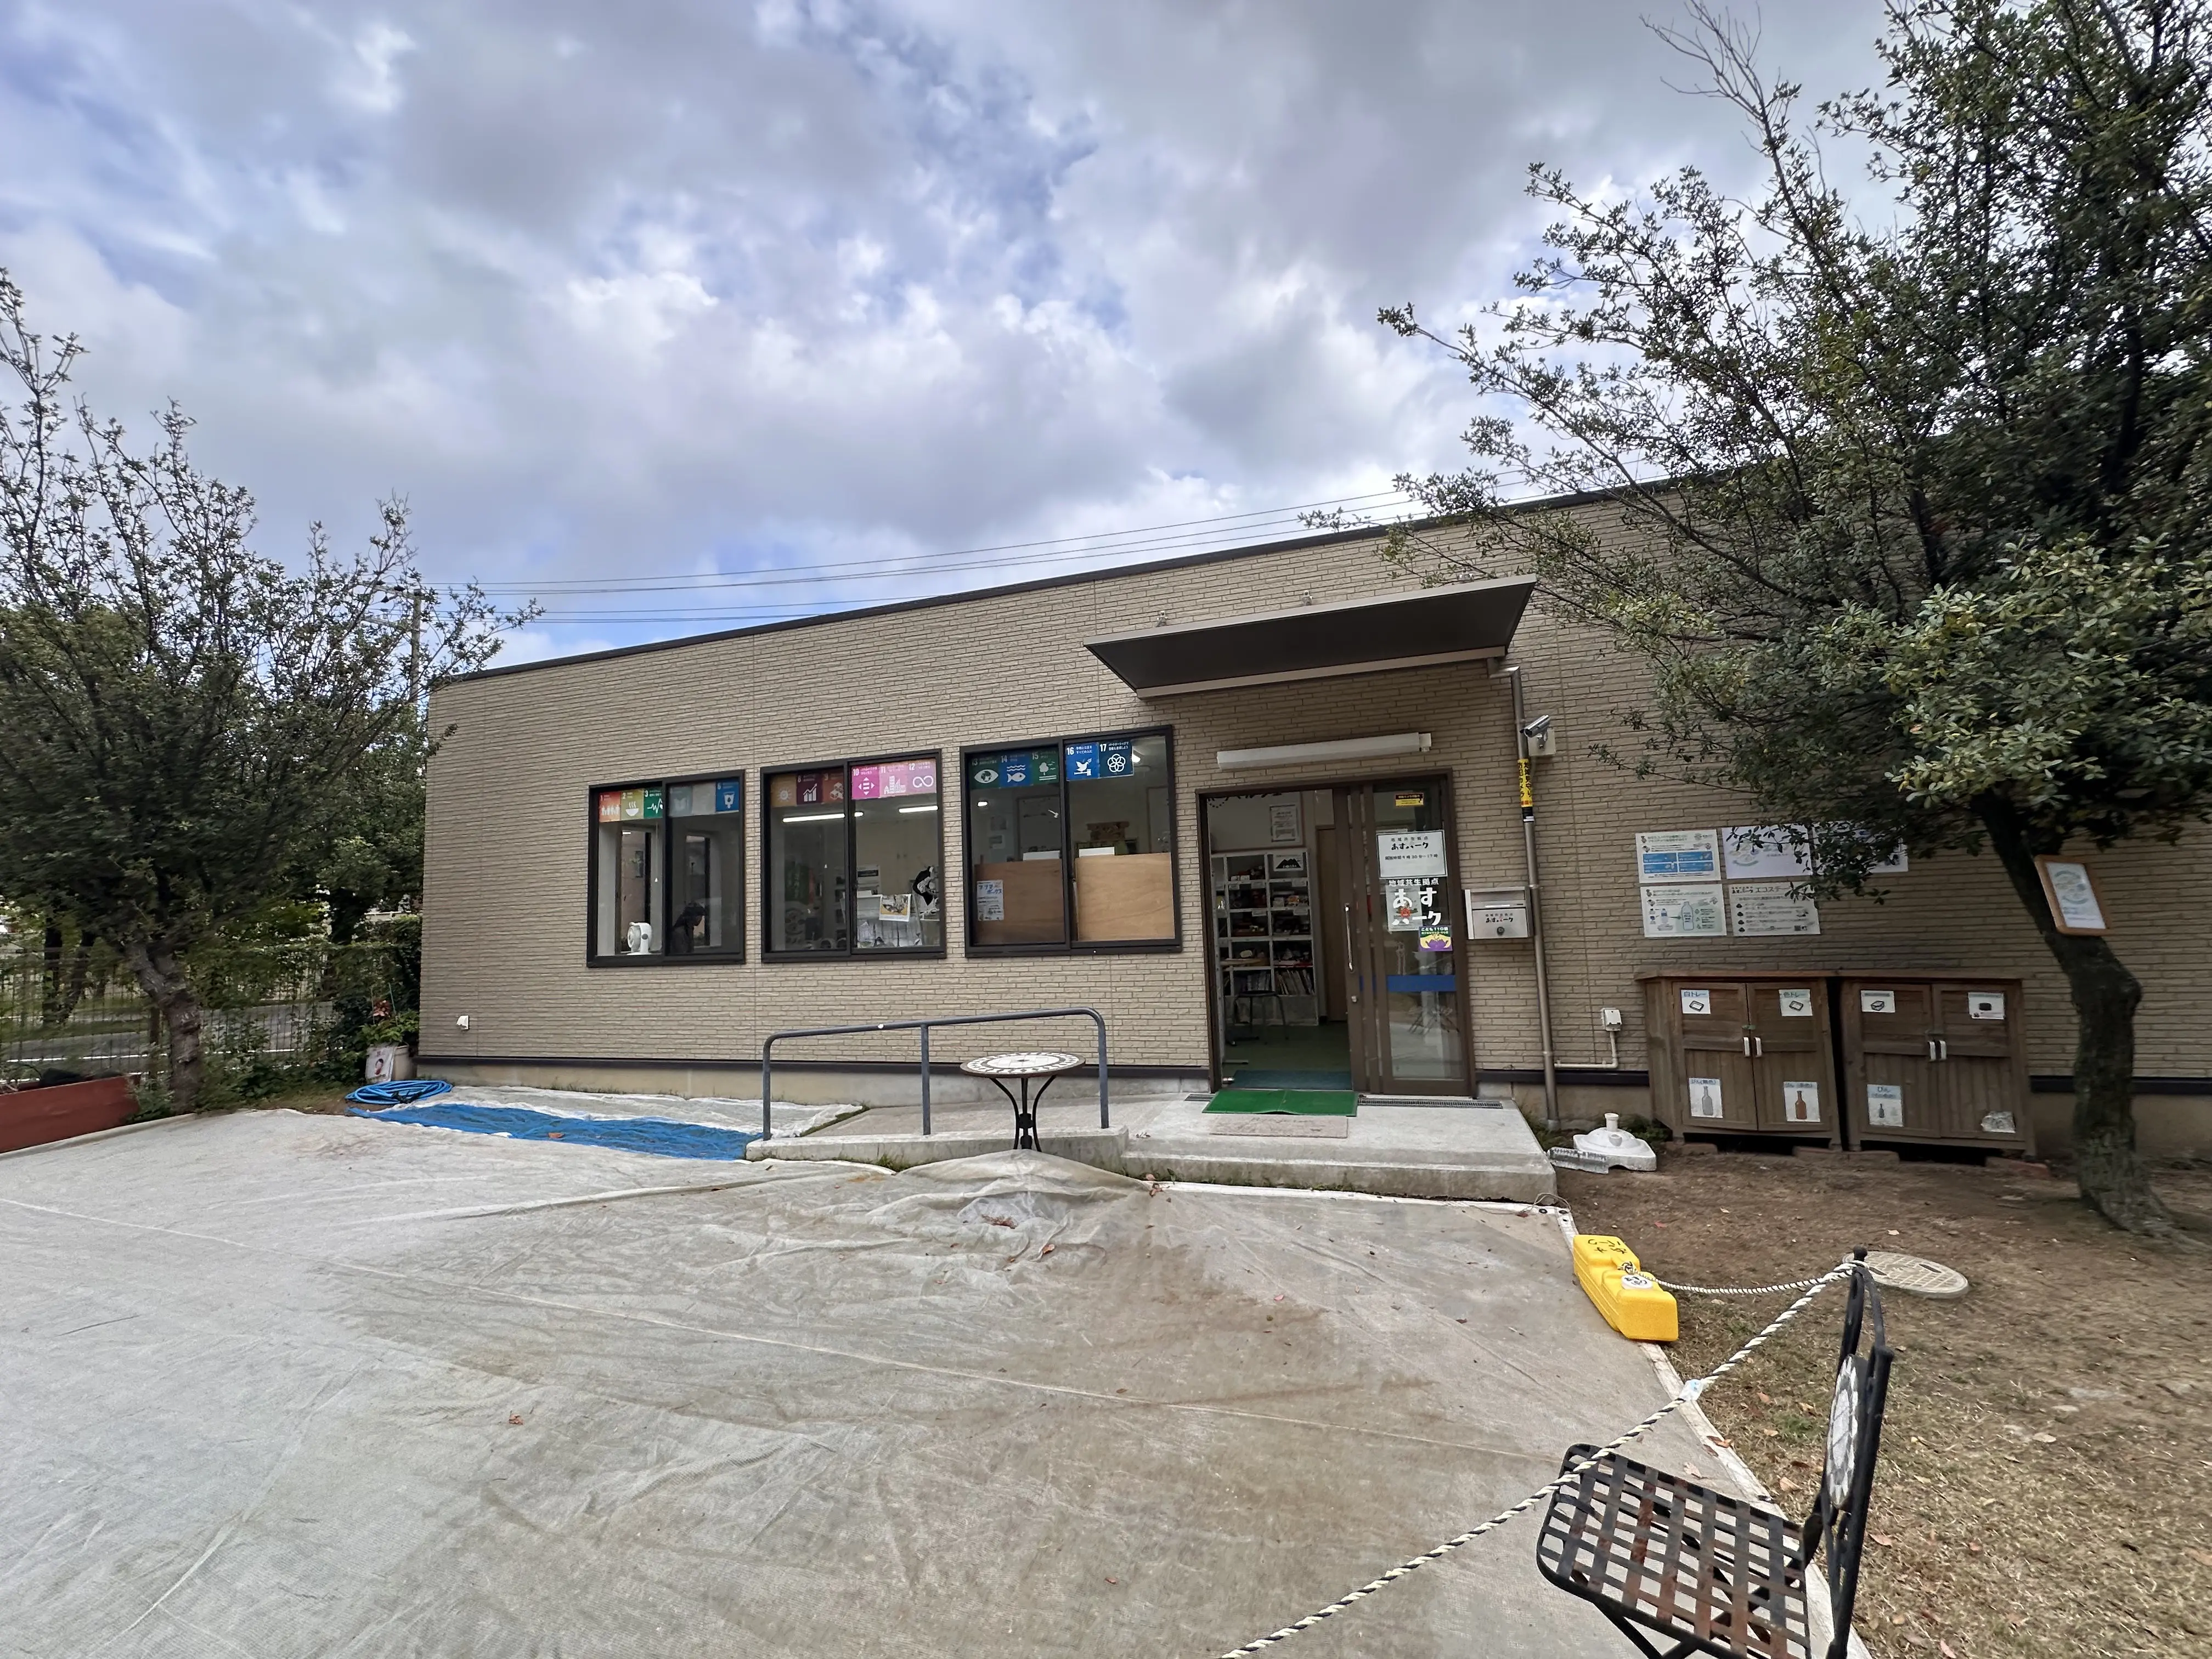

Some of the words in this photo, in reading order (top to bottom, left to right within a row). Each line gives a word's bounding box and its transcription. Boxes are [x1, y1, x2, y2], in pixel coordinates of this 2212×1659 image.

[1066, 747, 1074, 755] 16
[1100, 743, 1107, 752] 17
[1001, 755, 1008, 763] 14
[853, 768, 859, 776] 10
[1389, 878, 1439, 887] 地域共生拠点
[1393, 887, 1437, 909] あす
